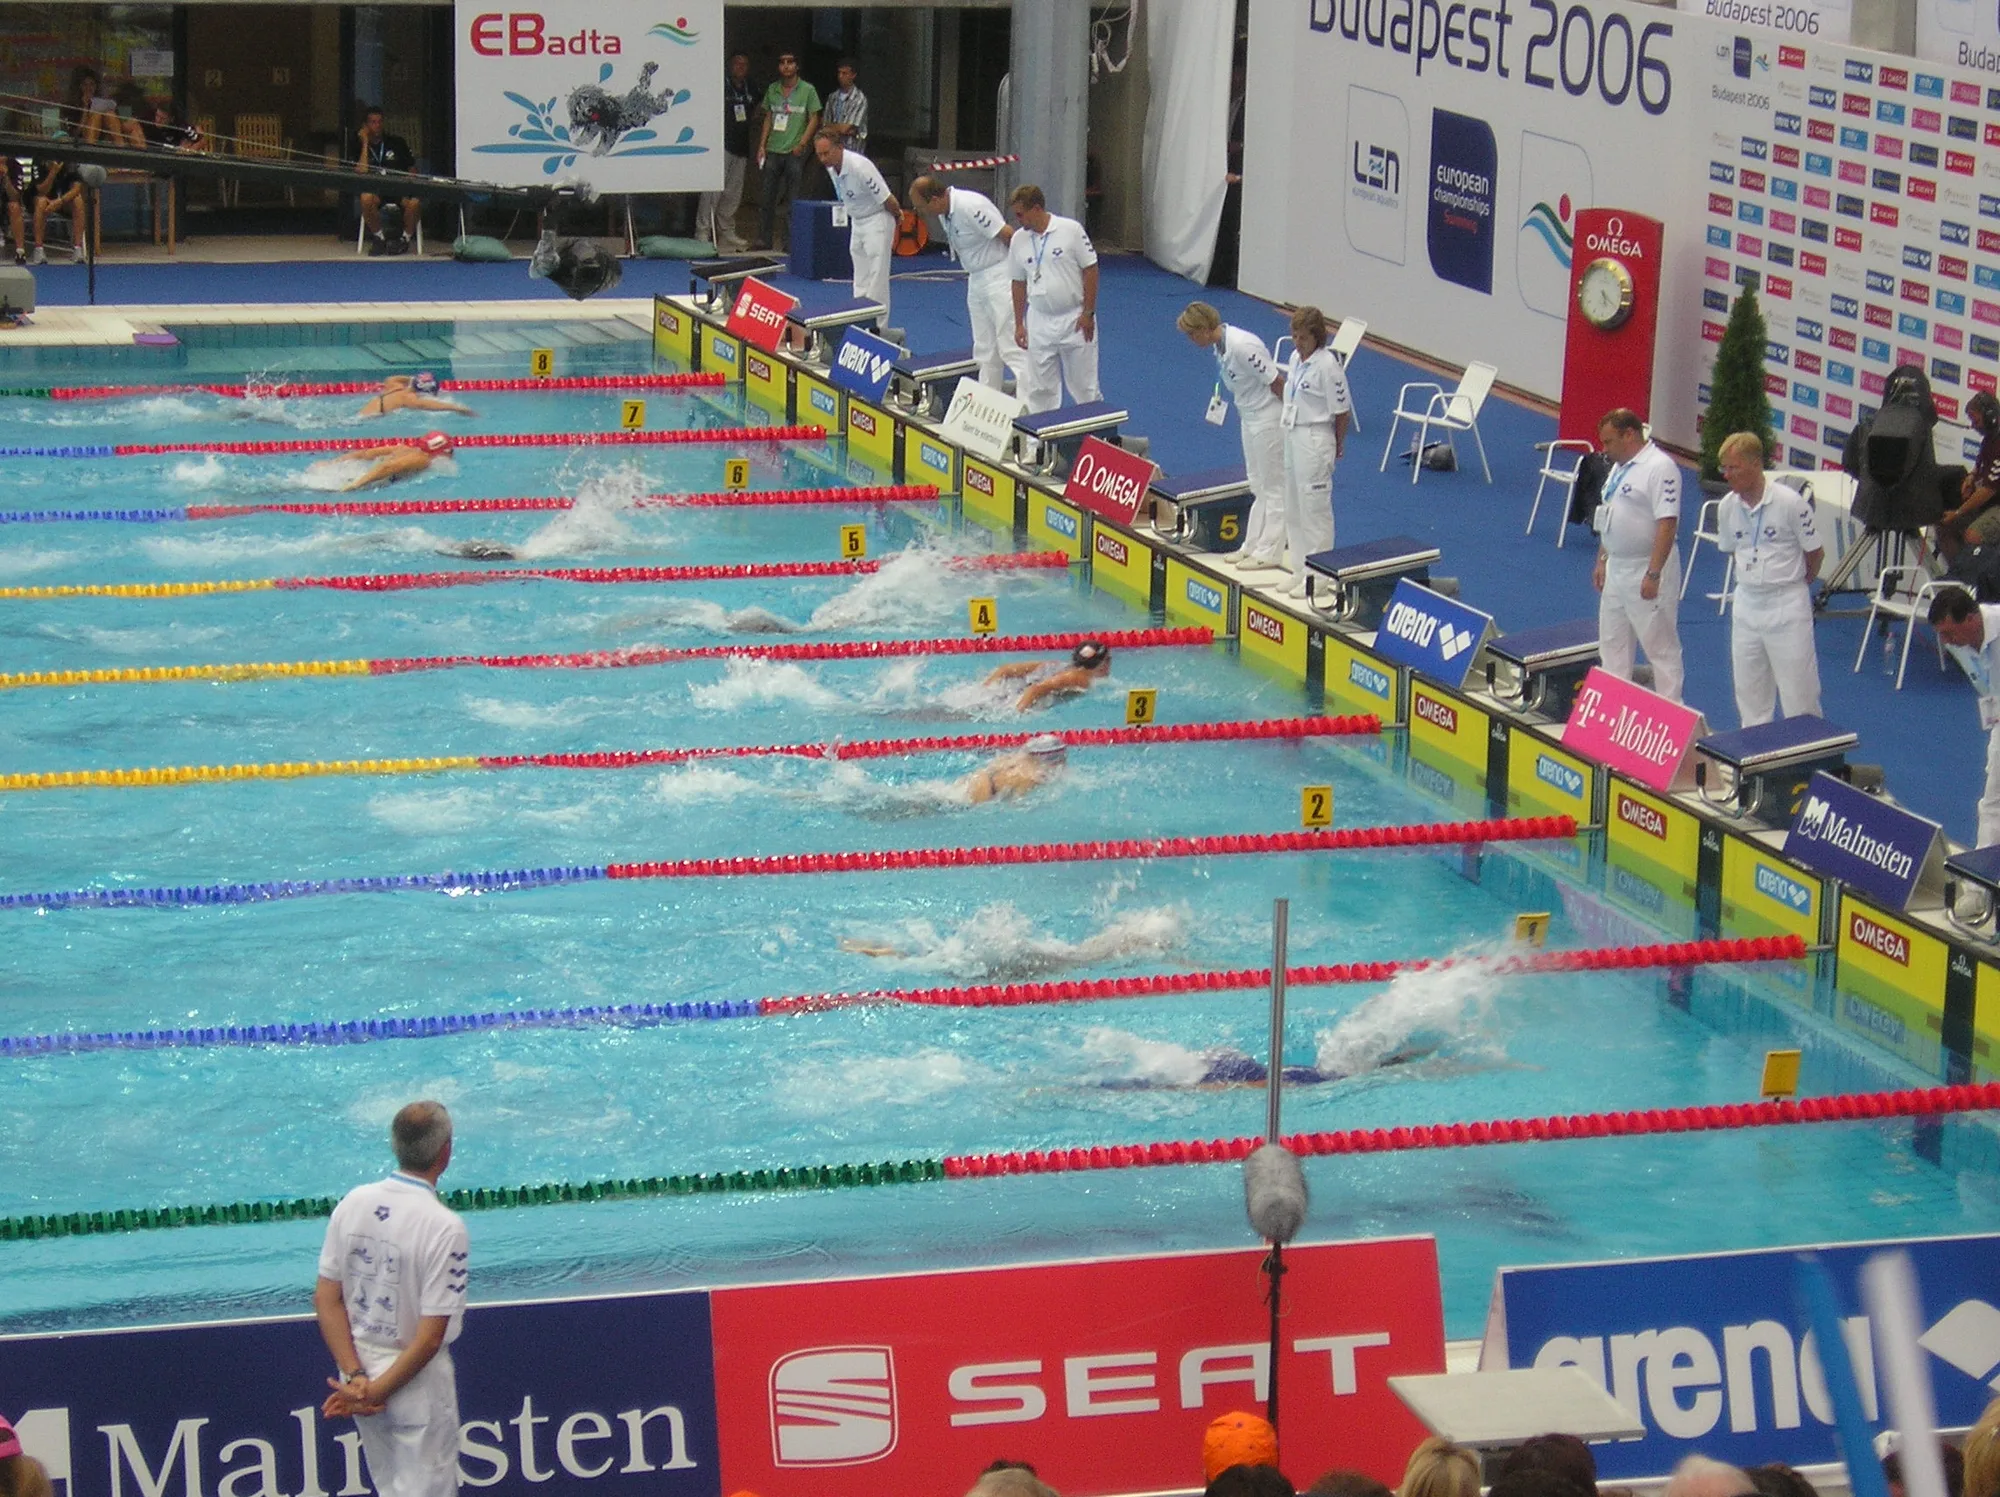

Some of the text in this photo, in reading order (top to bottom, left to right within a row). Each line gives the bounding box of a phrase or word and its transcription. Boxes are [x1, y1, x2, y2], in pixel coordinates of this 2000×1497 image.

[1706, 0, 1820, 35] Budapest 2006
[471, 13, 621, 56] EBadta
[1525, 0, 1674, 115] 2006
[1437, 165, 1489, 196] european
[1433, 187, 1490, 216] championships
[1587, 234, 1643, 258] OMEGA
[749, 303, 783, 329] SEAT
[539, 354, 547, 370] 8
[838, 341, 871, 375] arena
[629, 406, 639, 423] 7
[733, 467, 742, 484] 6
[1092, 467, 1141, 510] OMEGA
[849, 531, 859, 552] 5
[1220, 515, 1239, 540] 5
[1097, 535, 1127, 563] OMEGA
[978, 604, 989, 626] 4
[1249, 611, 1282, 640] OMEGA
[1387, 602, 1437, 648] arena
[1134, 696, 1147, 718] 3
[1417, 698, 1454, 731] OMEGA
[1311, 793, 1324, 819] 2
[1622, 801, 1664, 836] OMEGA
[1821, 813, 1913, 880] Malmsten
[1758, 869, 1789, 900] arena
[1854, 918, 1906, 962] OMEGA
[948, 1332, 1390, 1426] SEAT
[97, 1394, 698, 1497] Malsten
